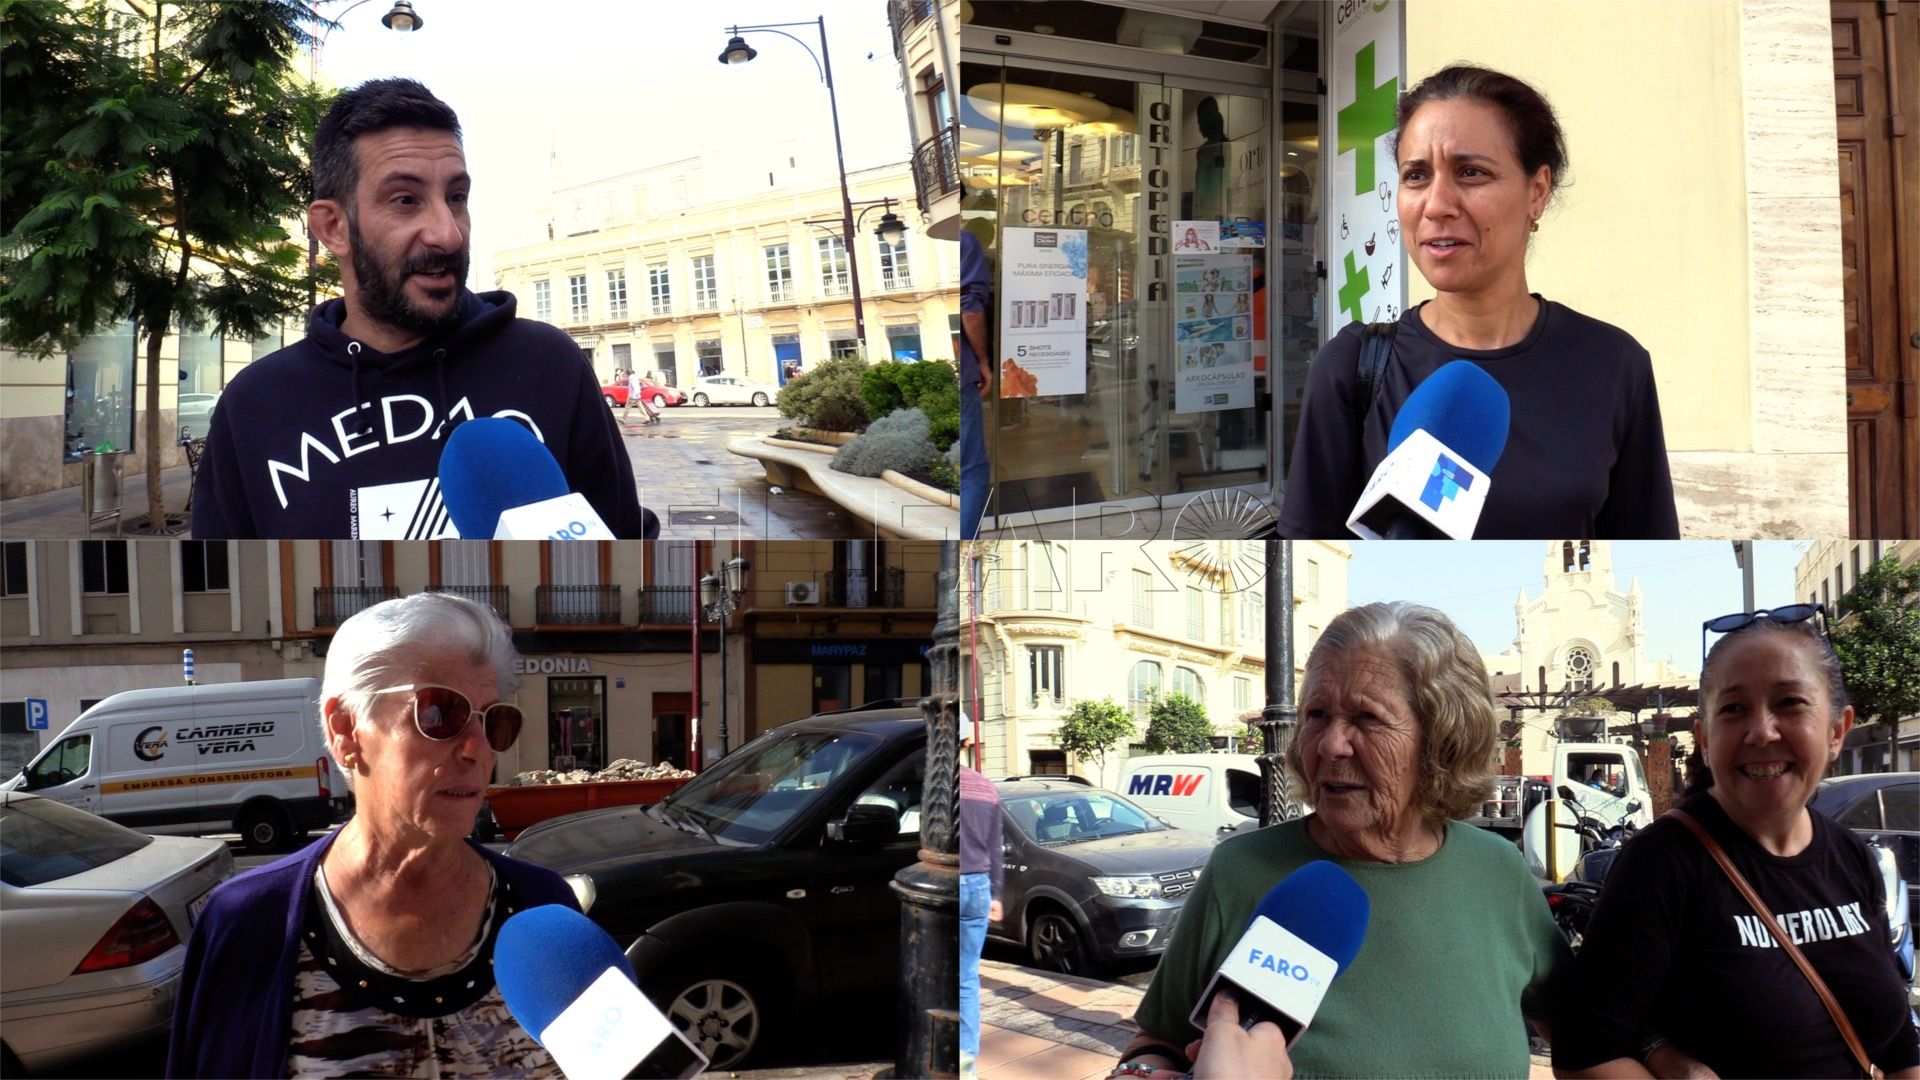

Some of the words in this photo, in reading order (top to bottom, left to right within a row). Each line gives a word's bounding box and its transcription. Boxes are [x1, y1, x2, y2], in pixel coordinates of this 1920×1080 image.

[1148, 102, 1170, 302] ORTOPEDIA
[1022, 205, 1113, 227] centro
[1017, 345, 1027, 357] 5
[811, 644, 867, 656] MARYPAZ
[175, 721, 275, 740] CARRERO
[197, 740, 256, 755] VERA
[123, 778, 184, 791] EMPRESA
[190, 770, 293, 784] CONSTRUCTORA
[1128, 774, 1204, 796] MRW
[1248, 948, 1308, 982] FARO
